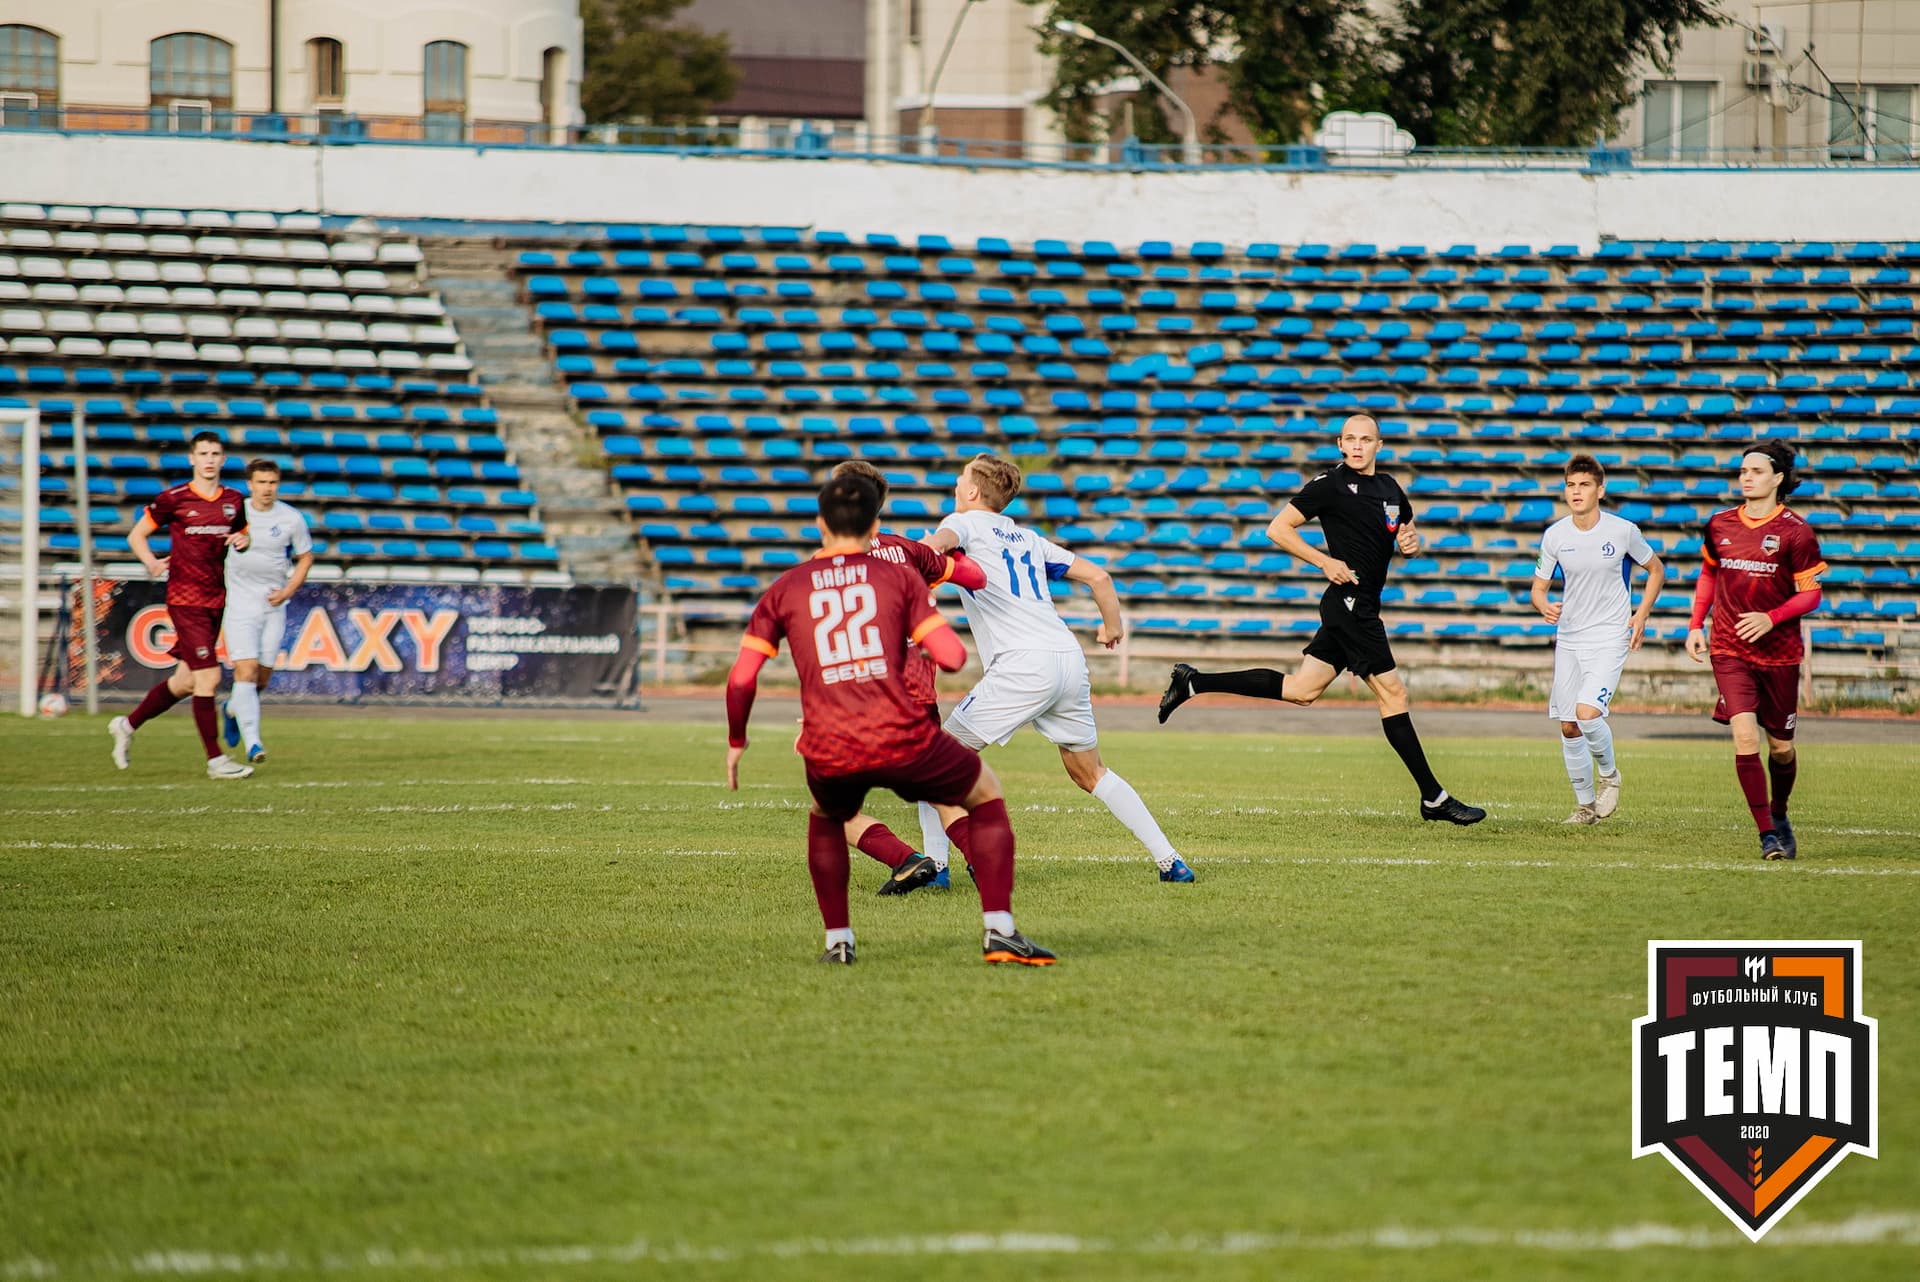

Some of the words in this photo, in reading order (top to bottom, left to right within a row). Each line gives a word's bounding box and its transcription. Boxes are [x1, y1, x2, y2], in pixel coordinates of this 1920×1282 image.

[811, 564, 867, 591] БАБИЧ
[1002, 547, 1044, 601] 11
[125, 603, 459, 672] GAXY
[809, 583, 884, 667] 22
